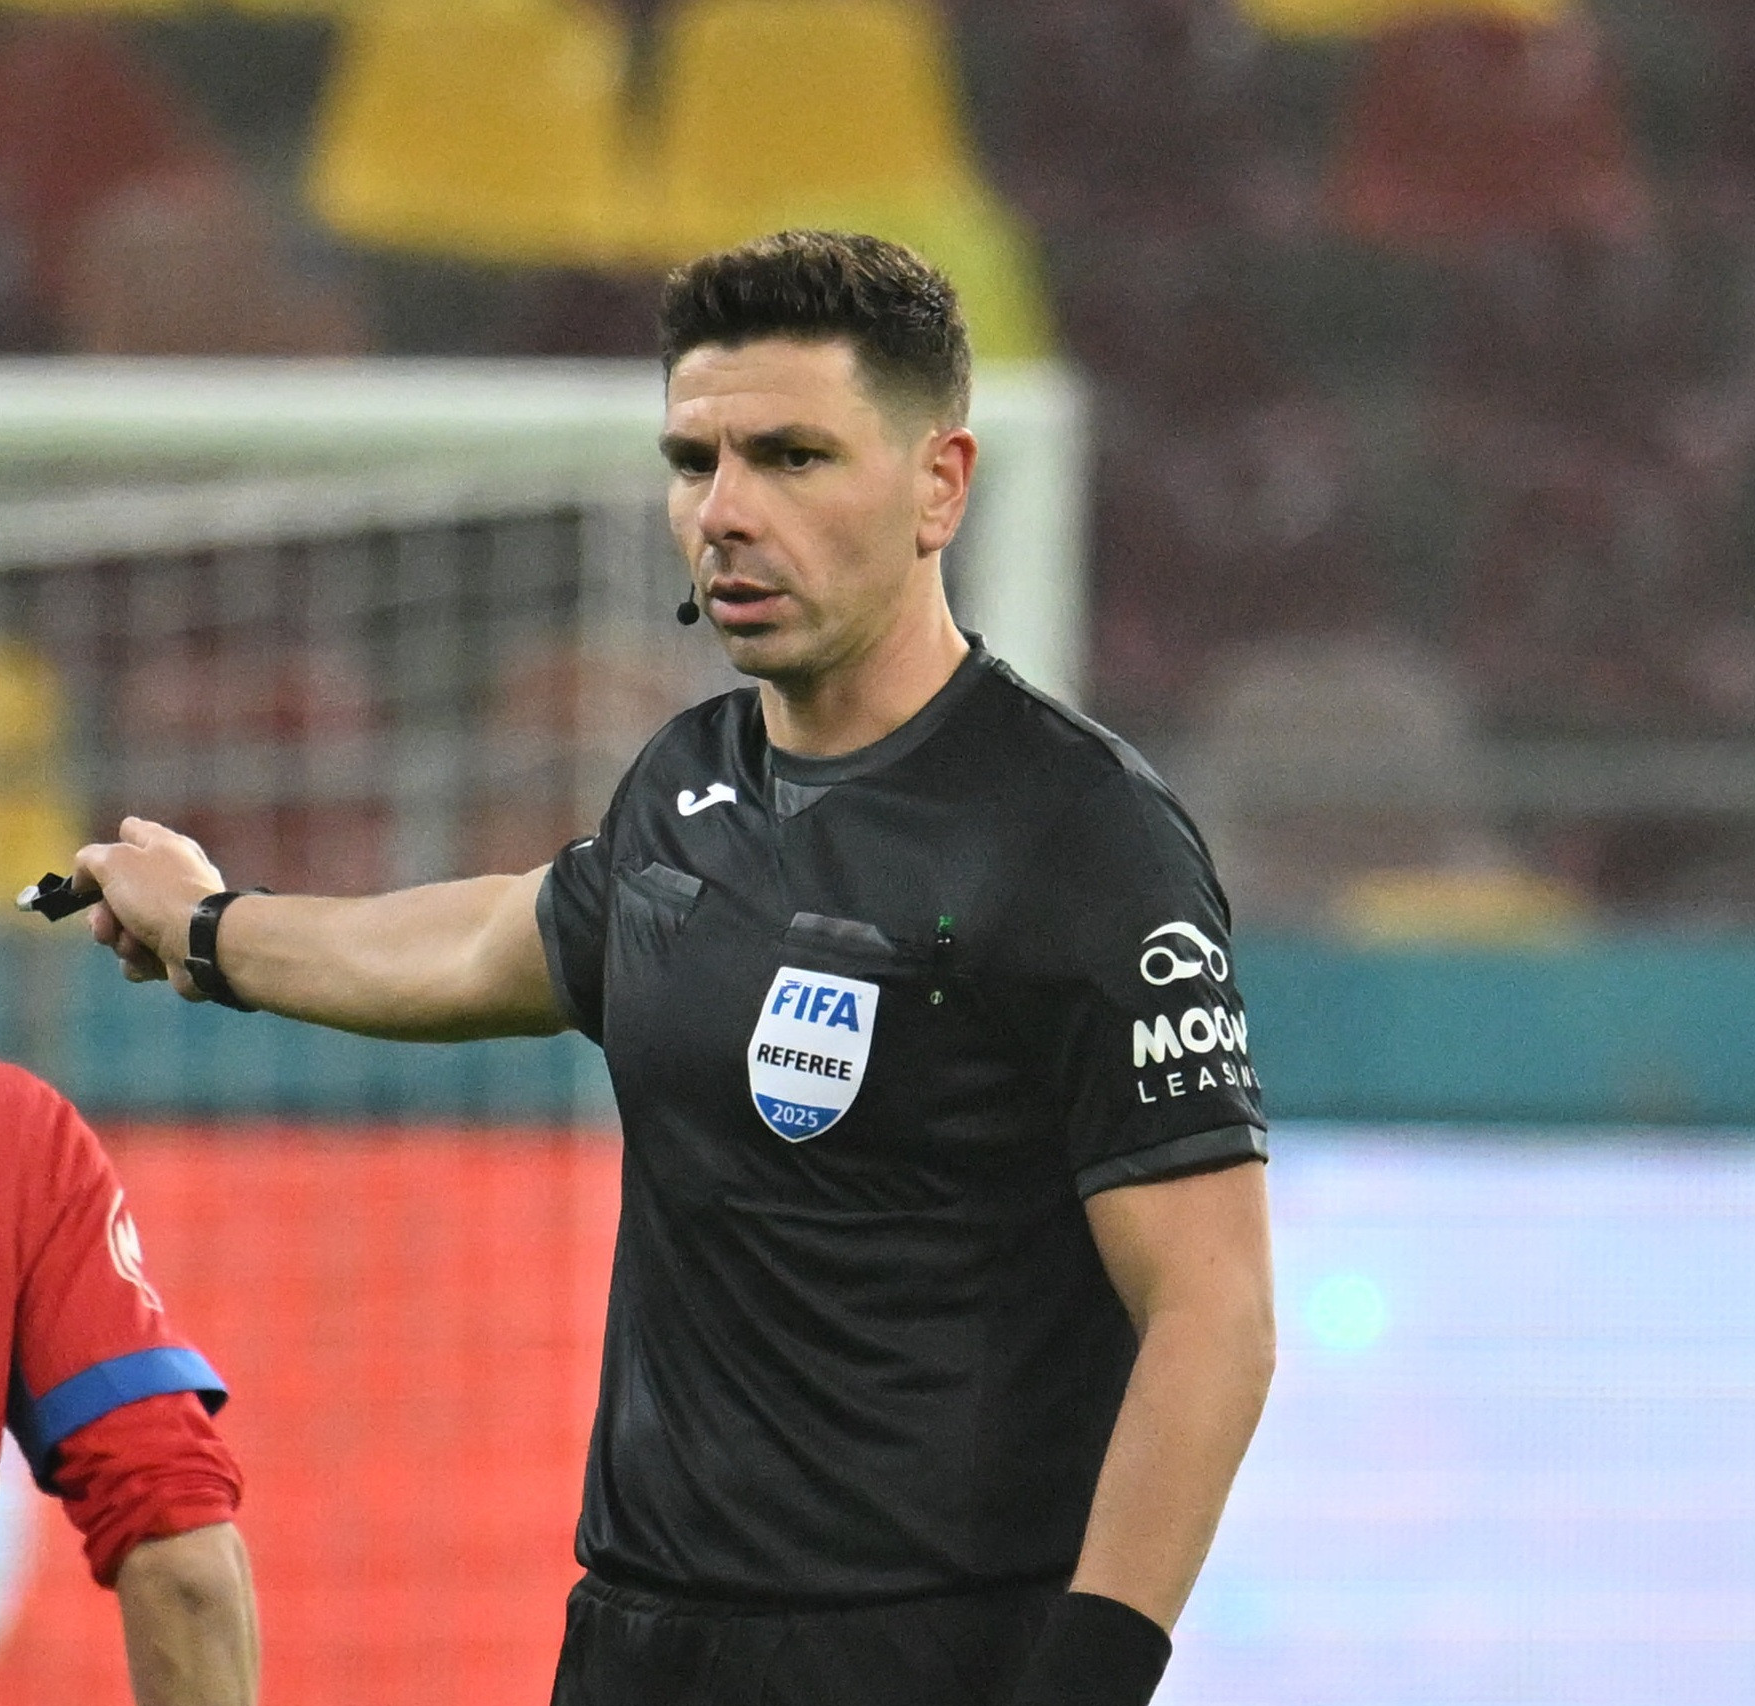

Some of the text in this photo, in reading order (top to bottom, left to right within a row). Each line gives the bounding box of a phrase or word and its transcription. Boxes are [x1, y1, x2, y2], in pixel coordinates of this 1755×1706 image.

[770, 979, 860, 1033] FIFA
[757, 1043, 853, 1081] REFEREE
[1137, 1062, 1262, 1103] LEASIN
[771, 1103, 819, 1128] 2025
